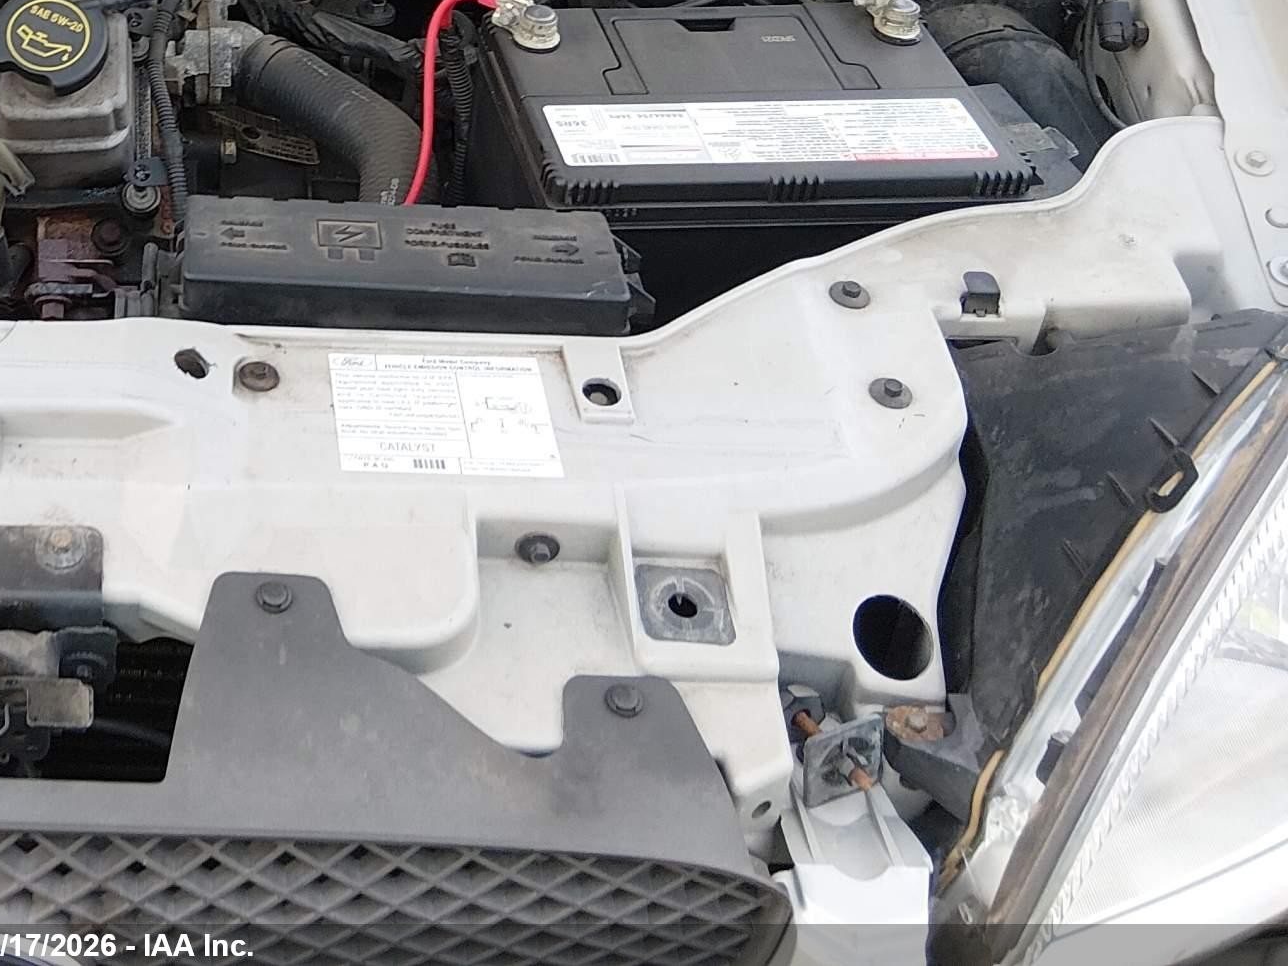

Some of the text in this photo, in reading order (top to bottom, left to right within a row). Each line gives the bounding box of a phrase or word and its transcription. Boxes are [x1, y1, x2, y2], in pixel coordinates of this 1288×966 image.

[29, 4, 84, 32] SAE 5W-20
[379, 442, 436, 453] CATALYST
